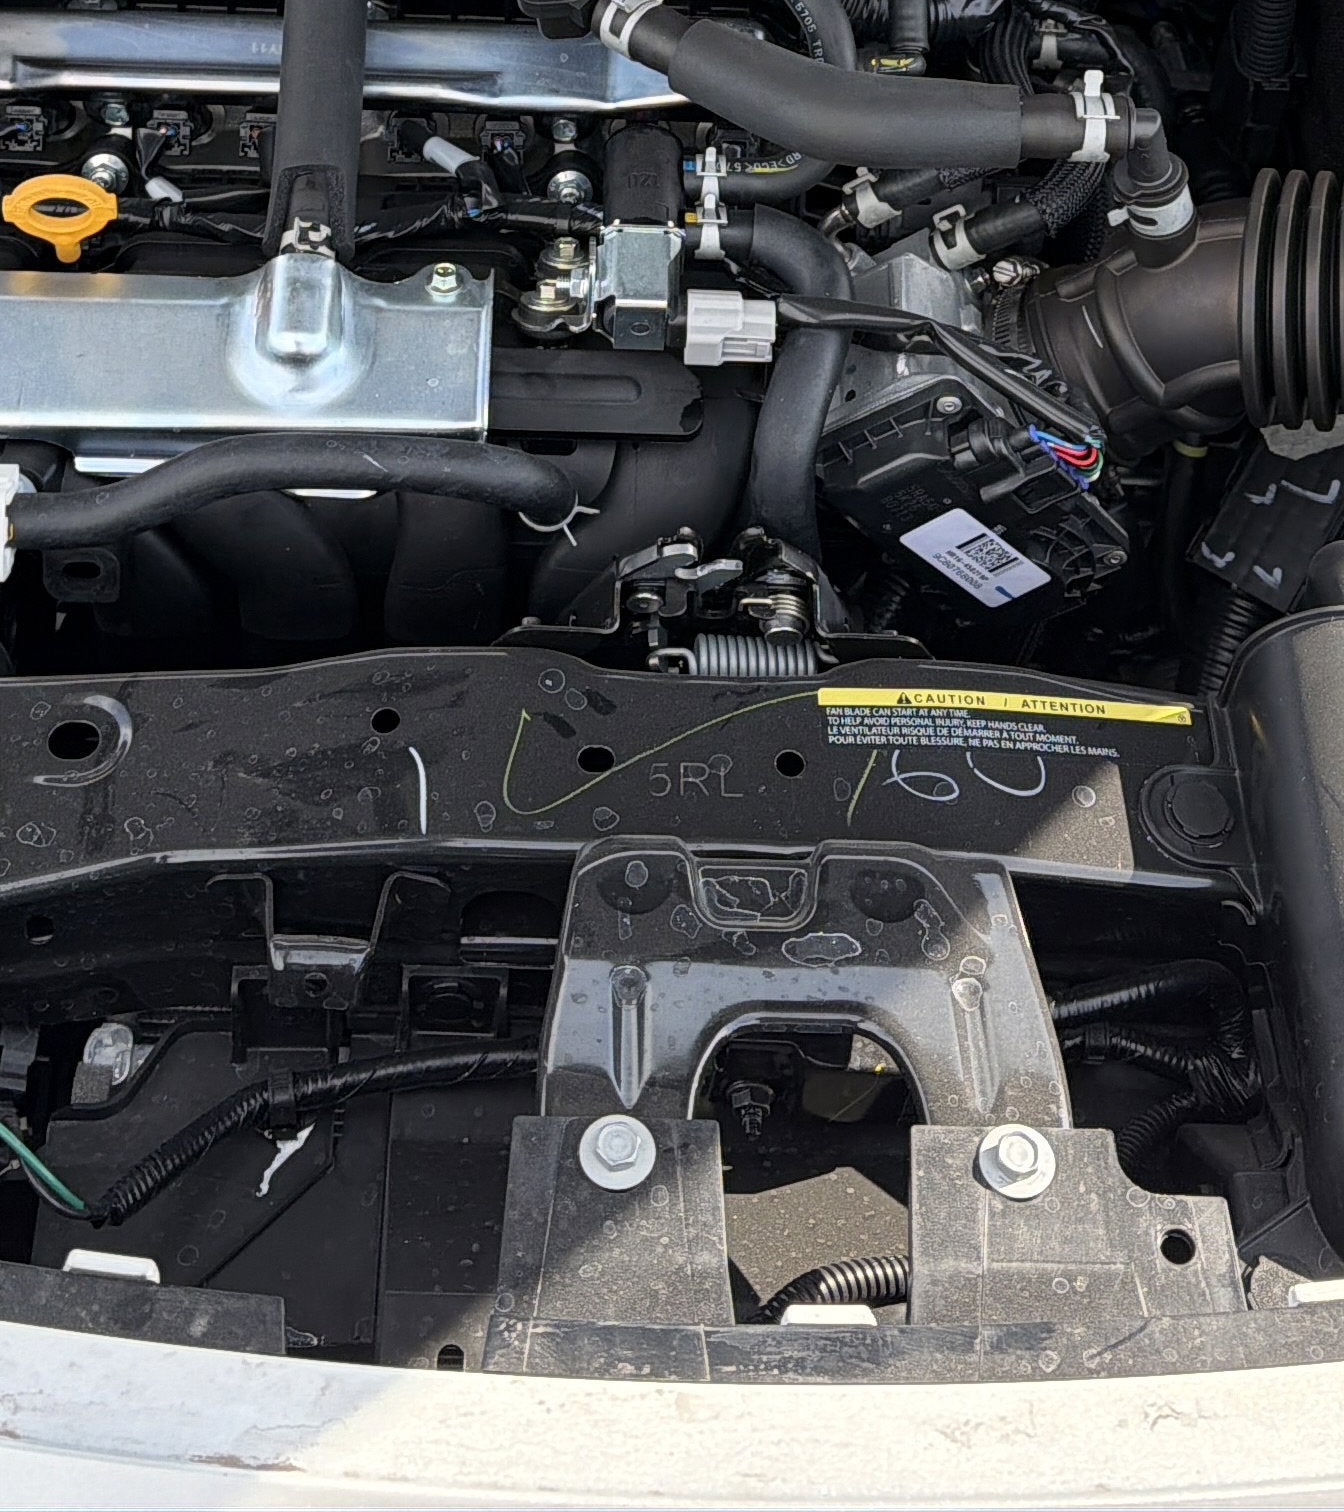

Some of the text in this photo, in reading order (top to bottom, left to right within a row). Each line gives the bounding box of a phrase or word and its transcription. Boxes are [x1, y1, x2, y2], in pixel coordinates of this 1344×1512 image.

[826, 707, 971, 718] FAN BLADE CAN START AT ANY TIME.
[913, 693, 985, 706] CAUTION
[1021, 699, 1106, 714] ATTENTION
[828, 717, 1046, 732] TO HELP AVOID PERSONAL INJURY, KEEP HANDS CLEAR.
[828, 726, 838, 734] LE
[840, 726, 900, 735] VENTILATEUR
[901, 726, 935, 736] RISQUE
[937, 727, 949, 736] DE
[951, 726, 1000, 738] DÉMARRER
[1010, 731, 1035, 740] TOUT
[1036, 733, 1079, 744] MOMENT.
[828, 735, 1120, 757] POUR ÉVITER TOUTE BLESSURE, NE PAS EN APPROCHER LES MAINS.
[649, 762, 744, 797] 5RL
